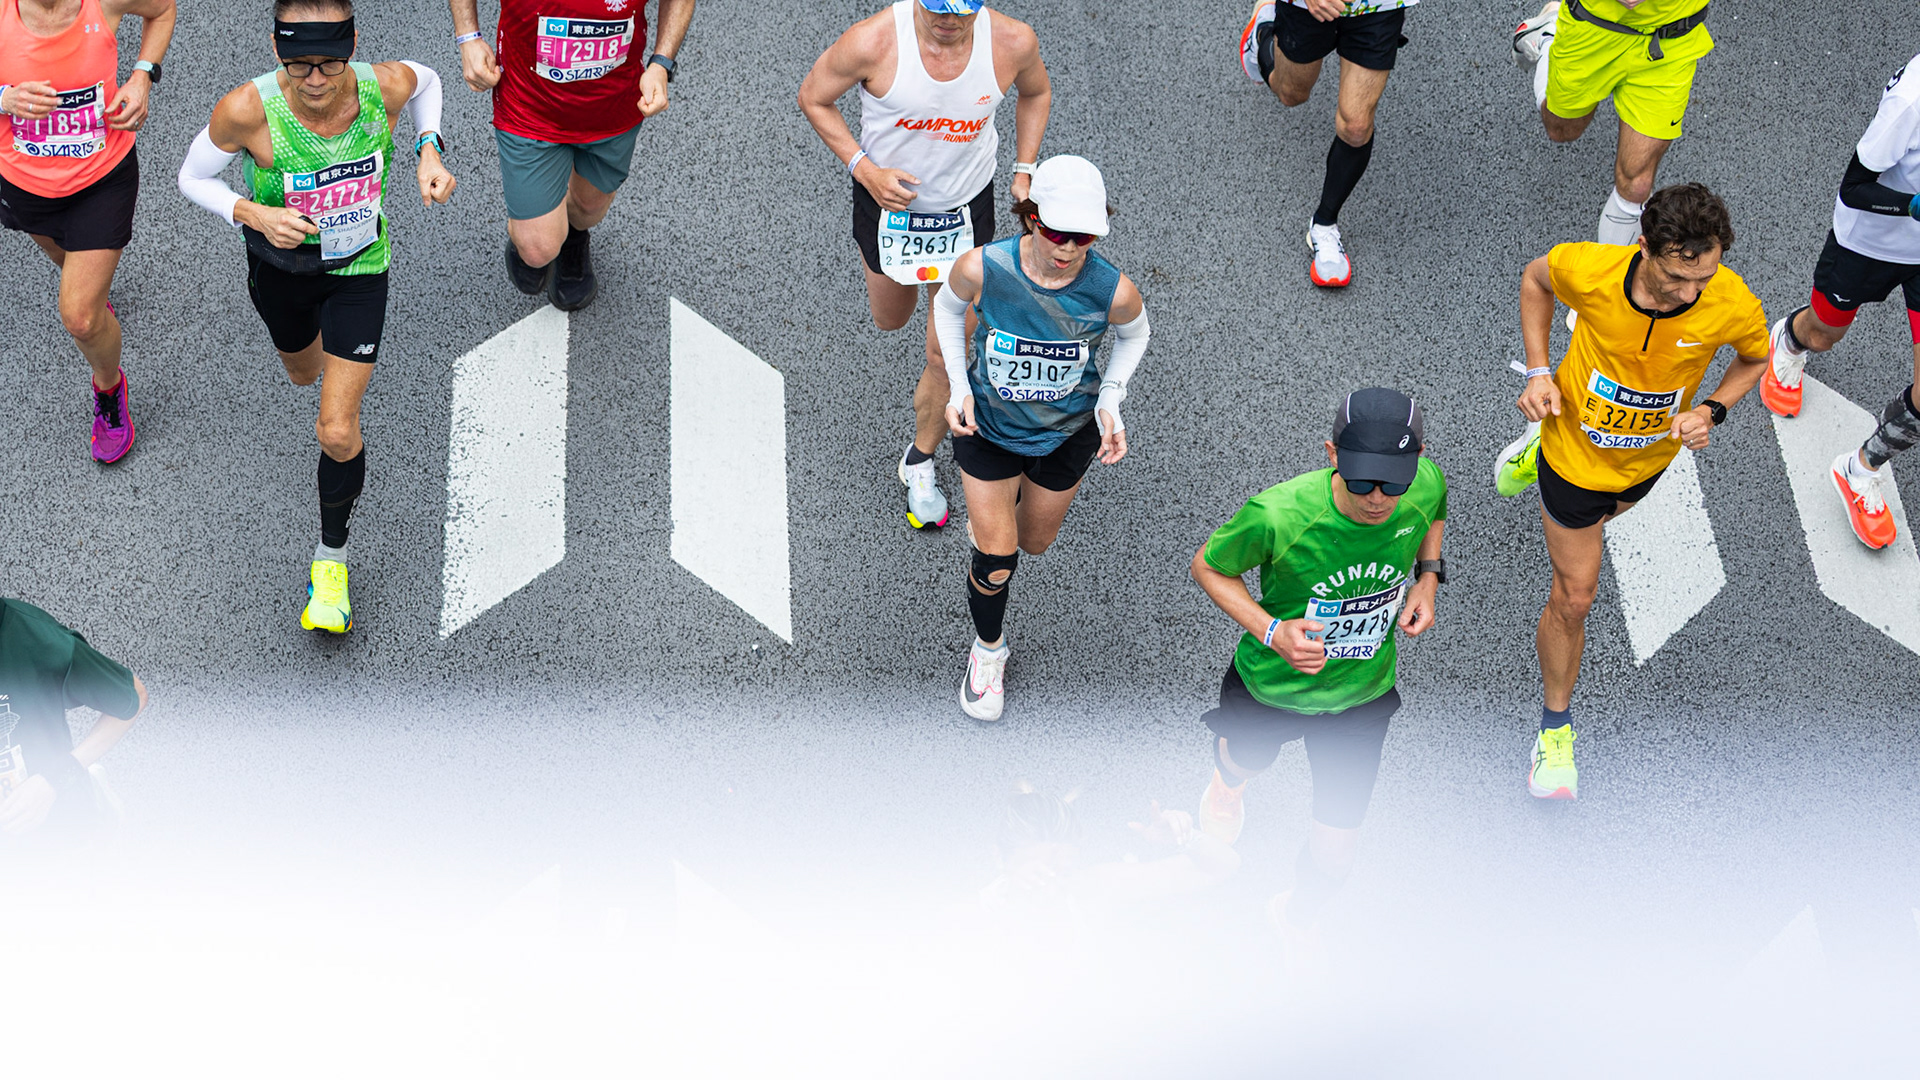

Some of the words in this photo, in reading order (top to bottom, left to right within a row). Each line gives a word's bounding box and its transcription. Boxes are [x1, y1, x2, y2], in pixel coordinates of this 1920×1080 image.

[572, 24, 624, 35] 東京メトロ
[540, 41, 552, 53] E
[561, 39, 619, 63] 12918
[61, 91, 94, 105] メトロ
[35, 109, 91, 136] 11851
[16, 130, 23, 139] 2
[319, 162, 373, 182] 東京メトロ
[288, 195, 302, 206] C
[309, 178, 370, 213] 24774
[912, 215, 962, 229] 東京メトロ
[882, 236, 893, 248] D
[901, 231, 959, 256] 29637
[886, 256, 892, 265] 2
[1020, 344, 1076, 357] 東京メトロ
[989, 357, 1001, 367] D
[992, 371, 998, 381] 2
[1008, 360, 1072, 382] 29107
[1586, 397, 1597, 412] E
[1619, 391, 1673, 406] 東京メトロ
[1583, 415, 1590, 425] 2
[1600, 404, 1667, 430] 32155
[1344, 590, 1397, 613] 東京メトロ
[1324, 608, 1389, 640] 29478
